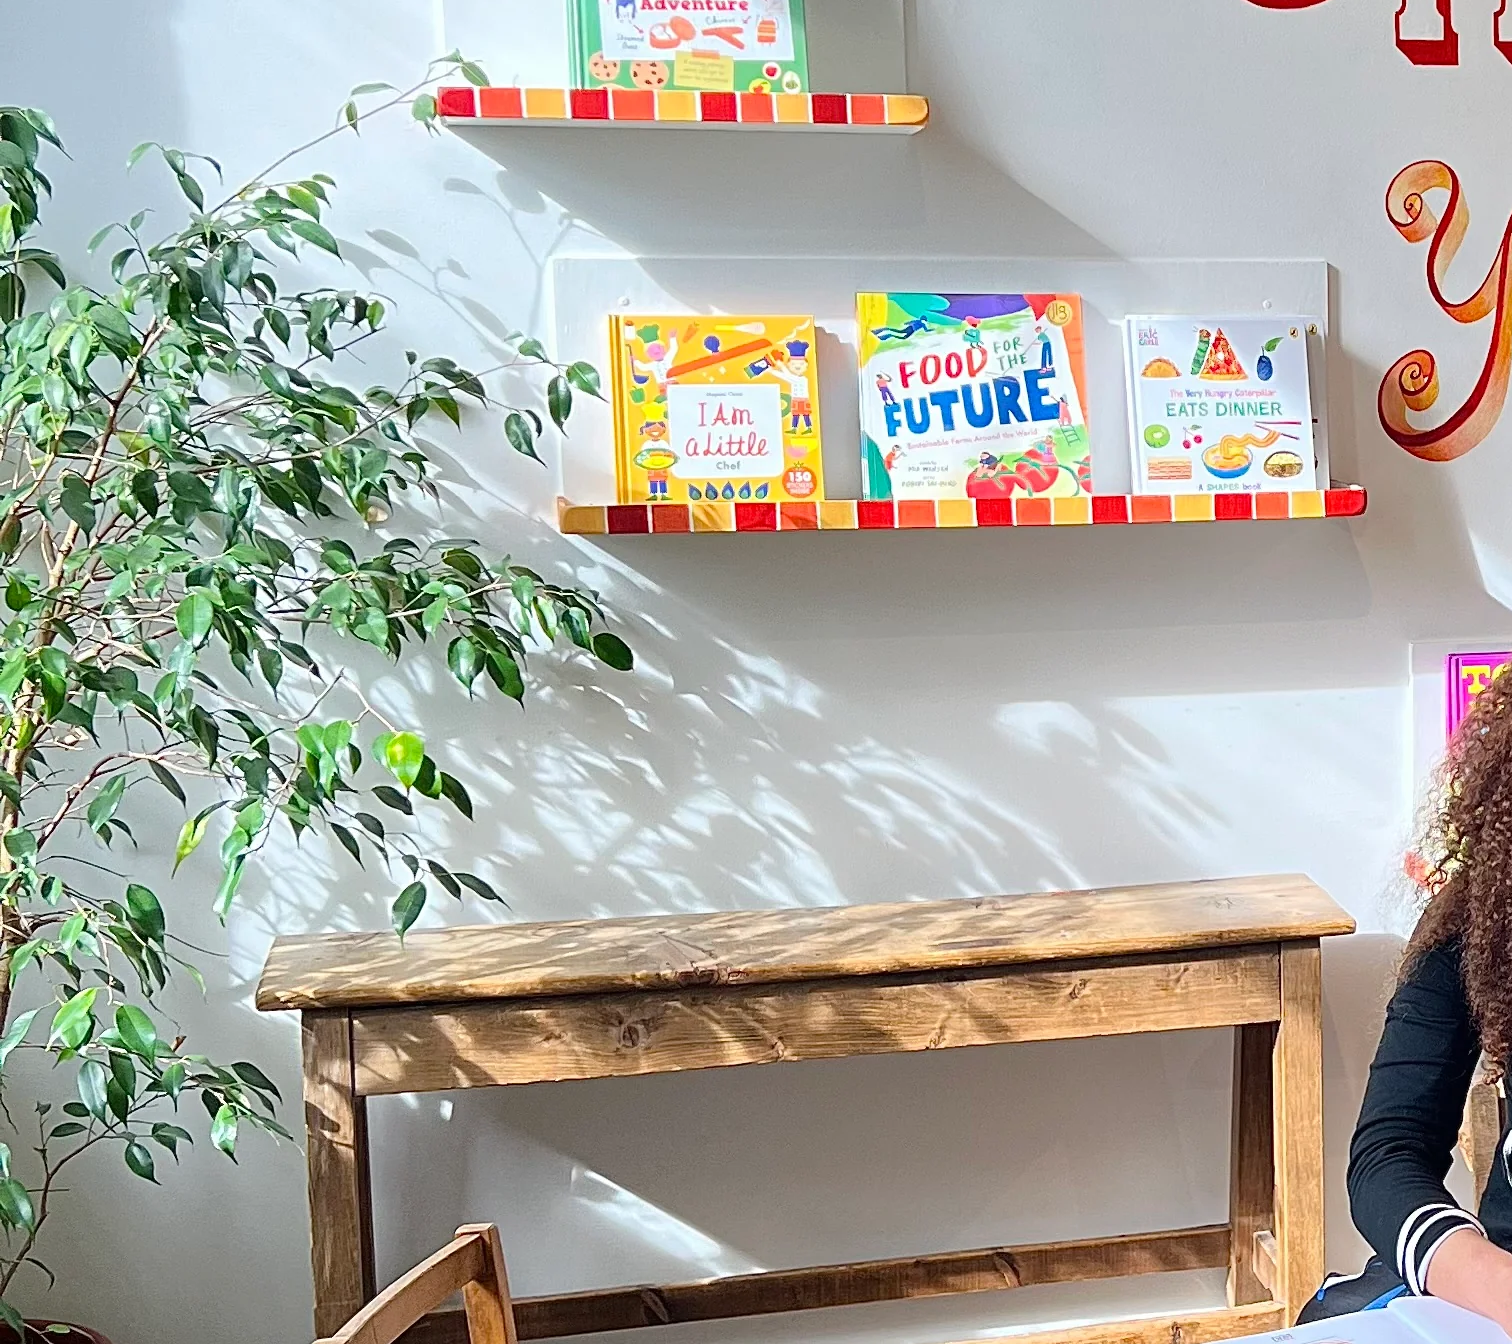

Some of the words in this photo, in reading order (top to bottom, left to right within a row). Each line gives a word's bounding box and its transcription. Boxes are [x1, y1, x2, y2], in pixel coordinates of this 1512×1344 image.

[899, 347, 987, 388] FOOD
[993, 336, 1024, 353] FOR
[998, 352, 1028, 371] THE
[698, 402, 708, 427] I
[1166, 402, 1209, 417] EATS
[1215, 401, 1283, 417] DINNER
[685, 438, 700, 457] a
[703, 432, 769, 457] Little
[716, 461, 741, 471] Chef
